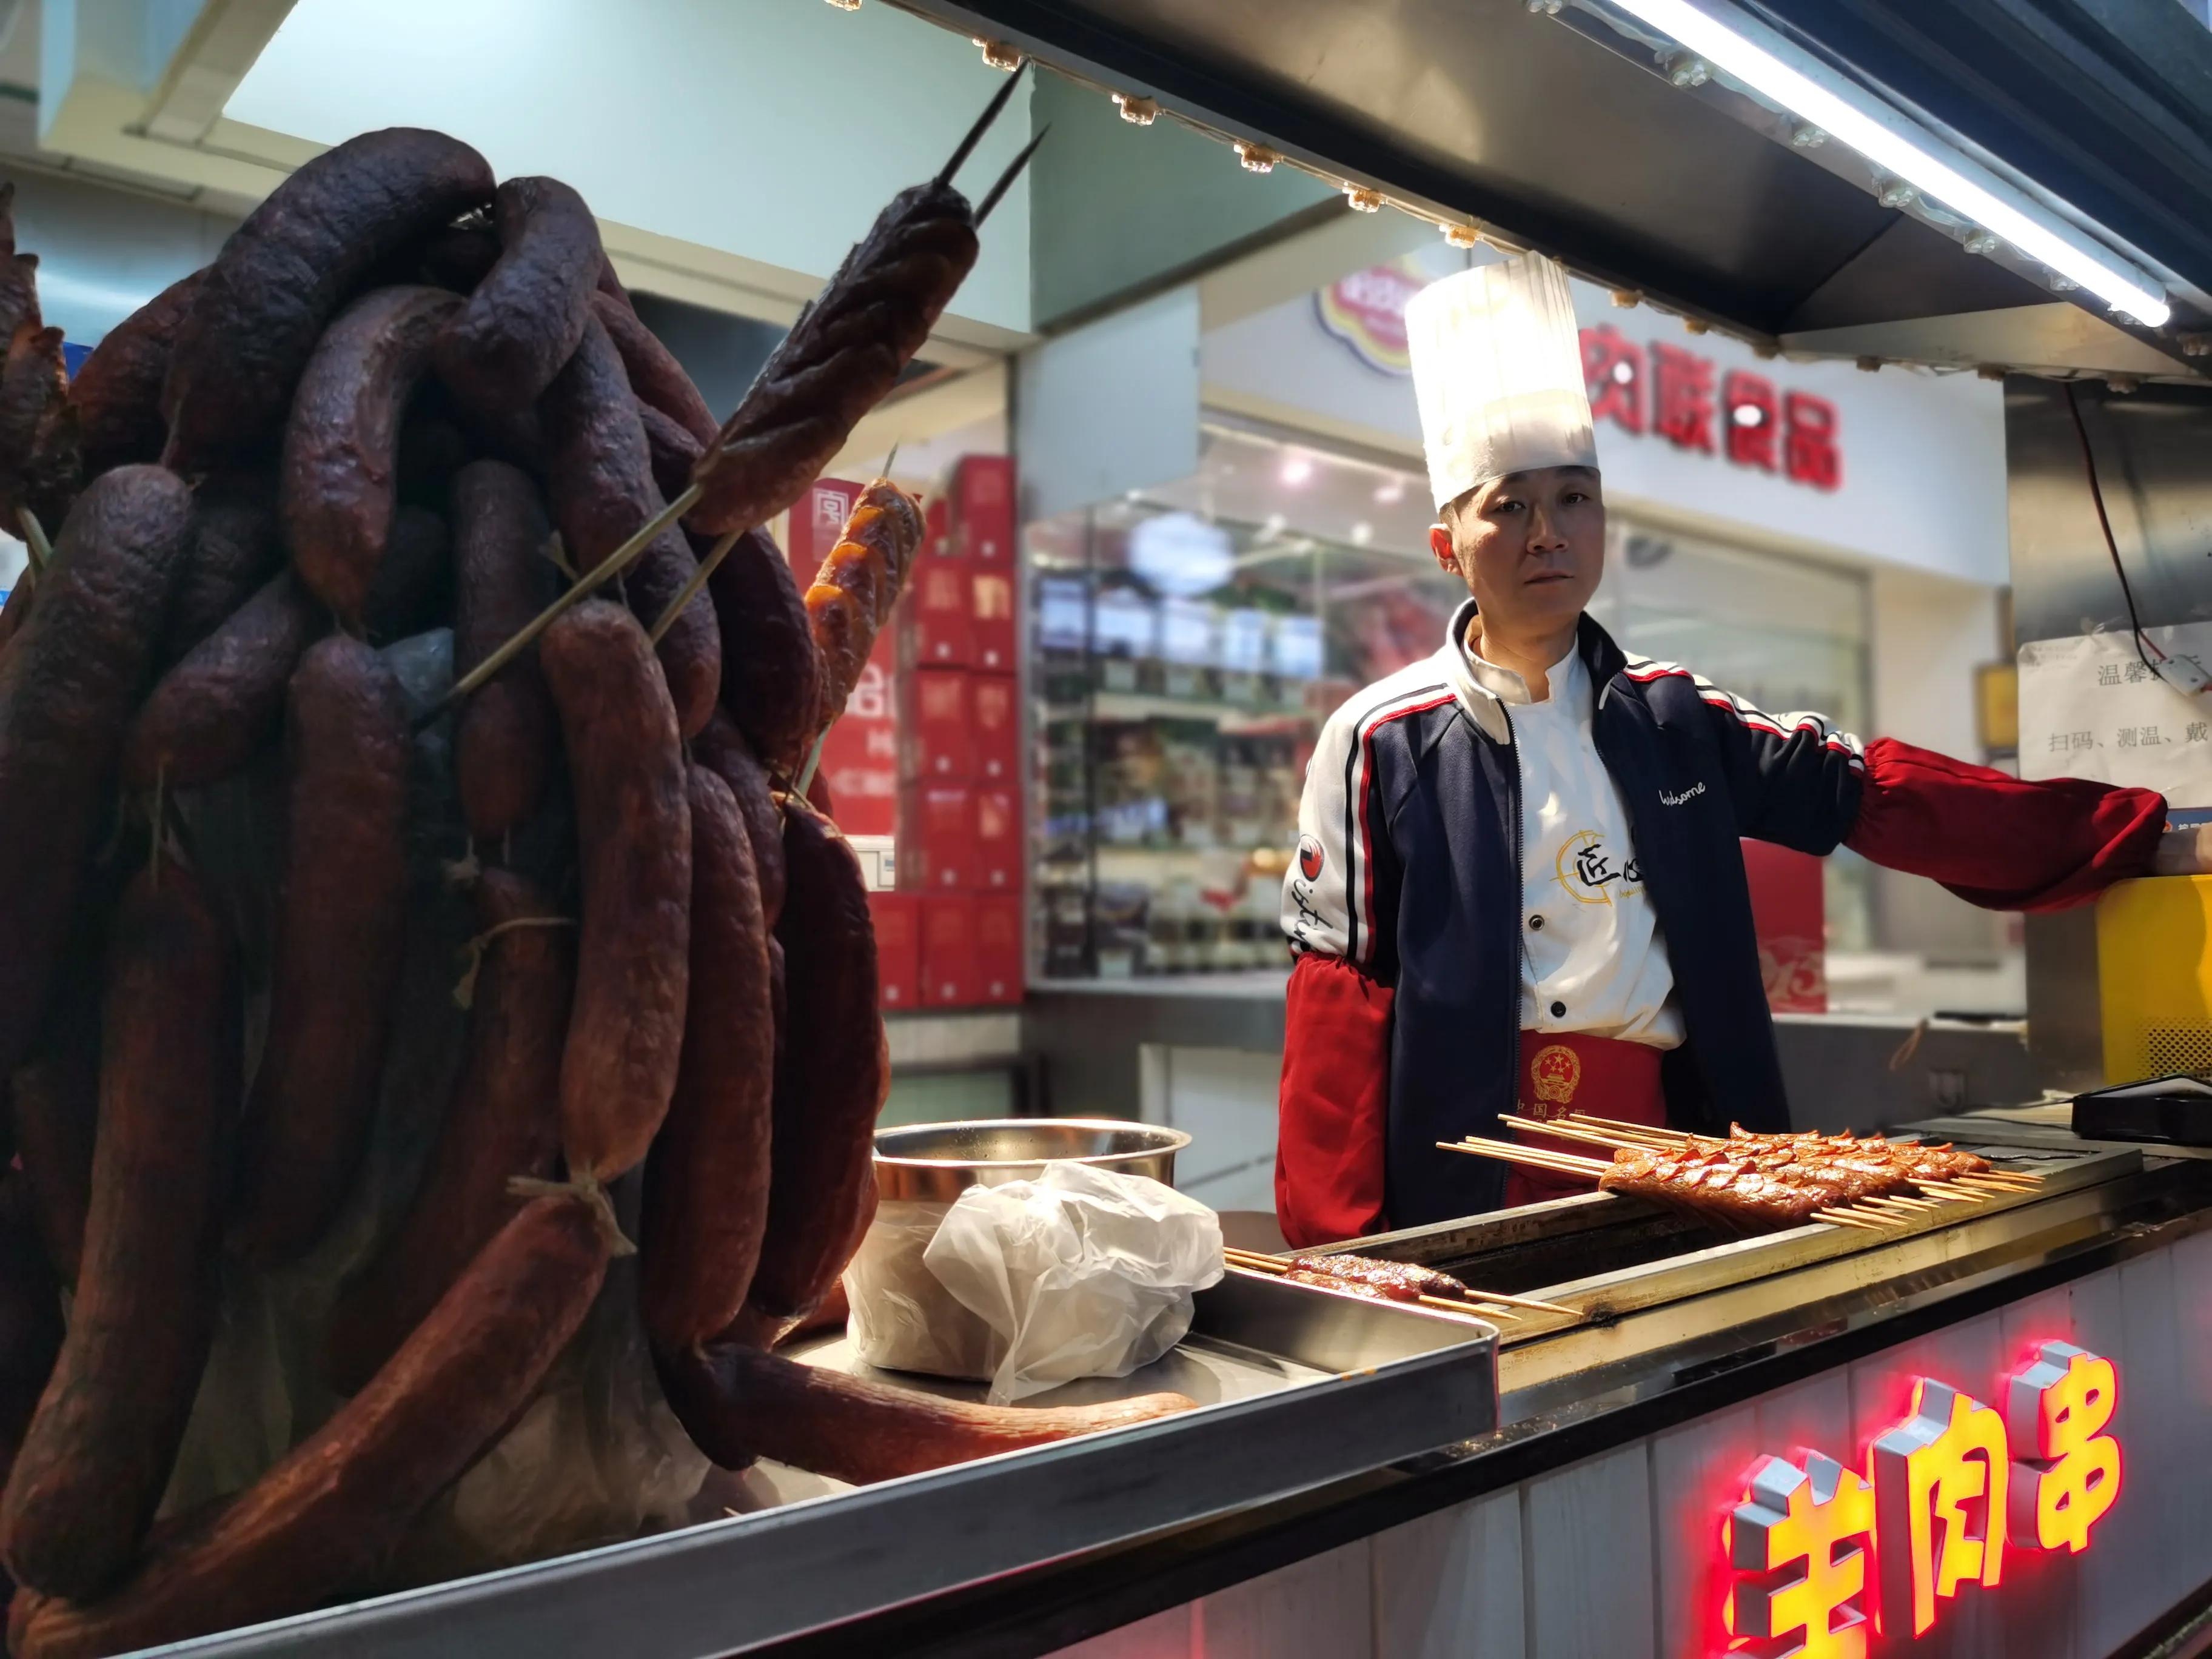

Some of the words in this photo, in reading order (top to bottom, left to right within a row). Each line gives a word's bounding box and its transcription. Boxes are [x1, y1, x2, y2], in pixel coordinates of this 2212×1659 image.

[2097, 654, 2198, 686] 温馨
[2048, 722, 2208, 752] 扫码、测温、戴
[1738, 1341, 2123, 1659] 羊肉串
